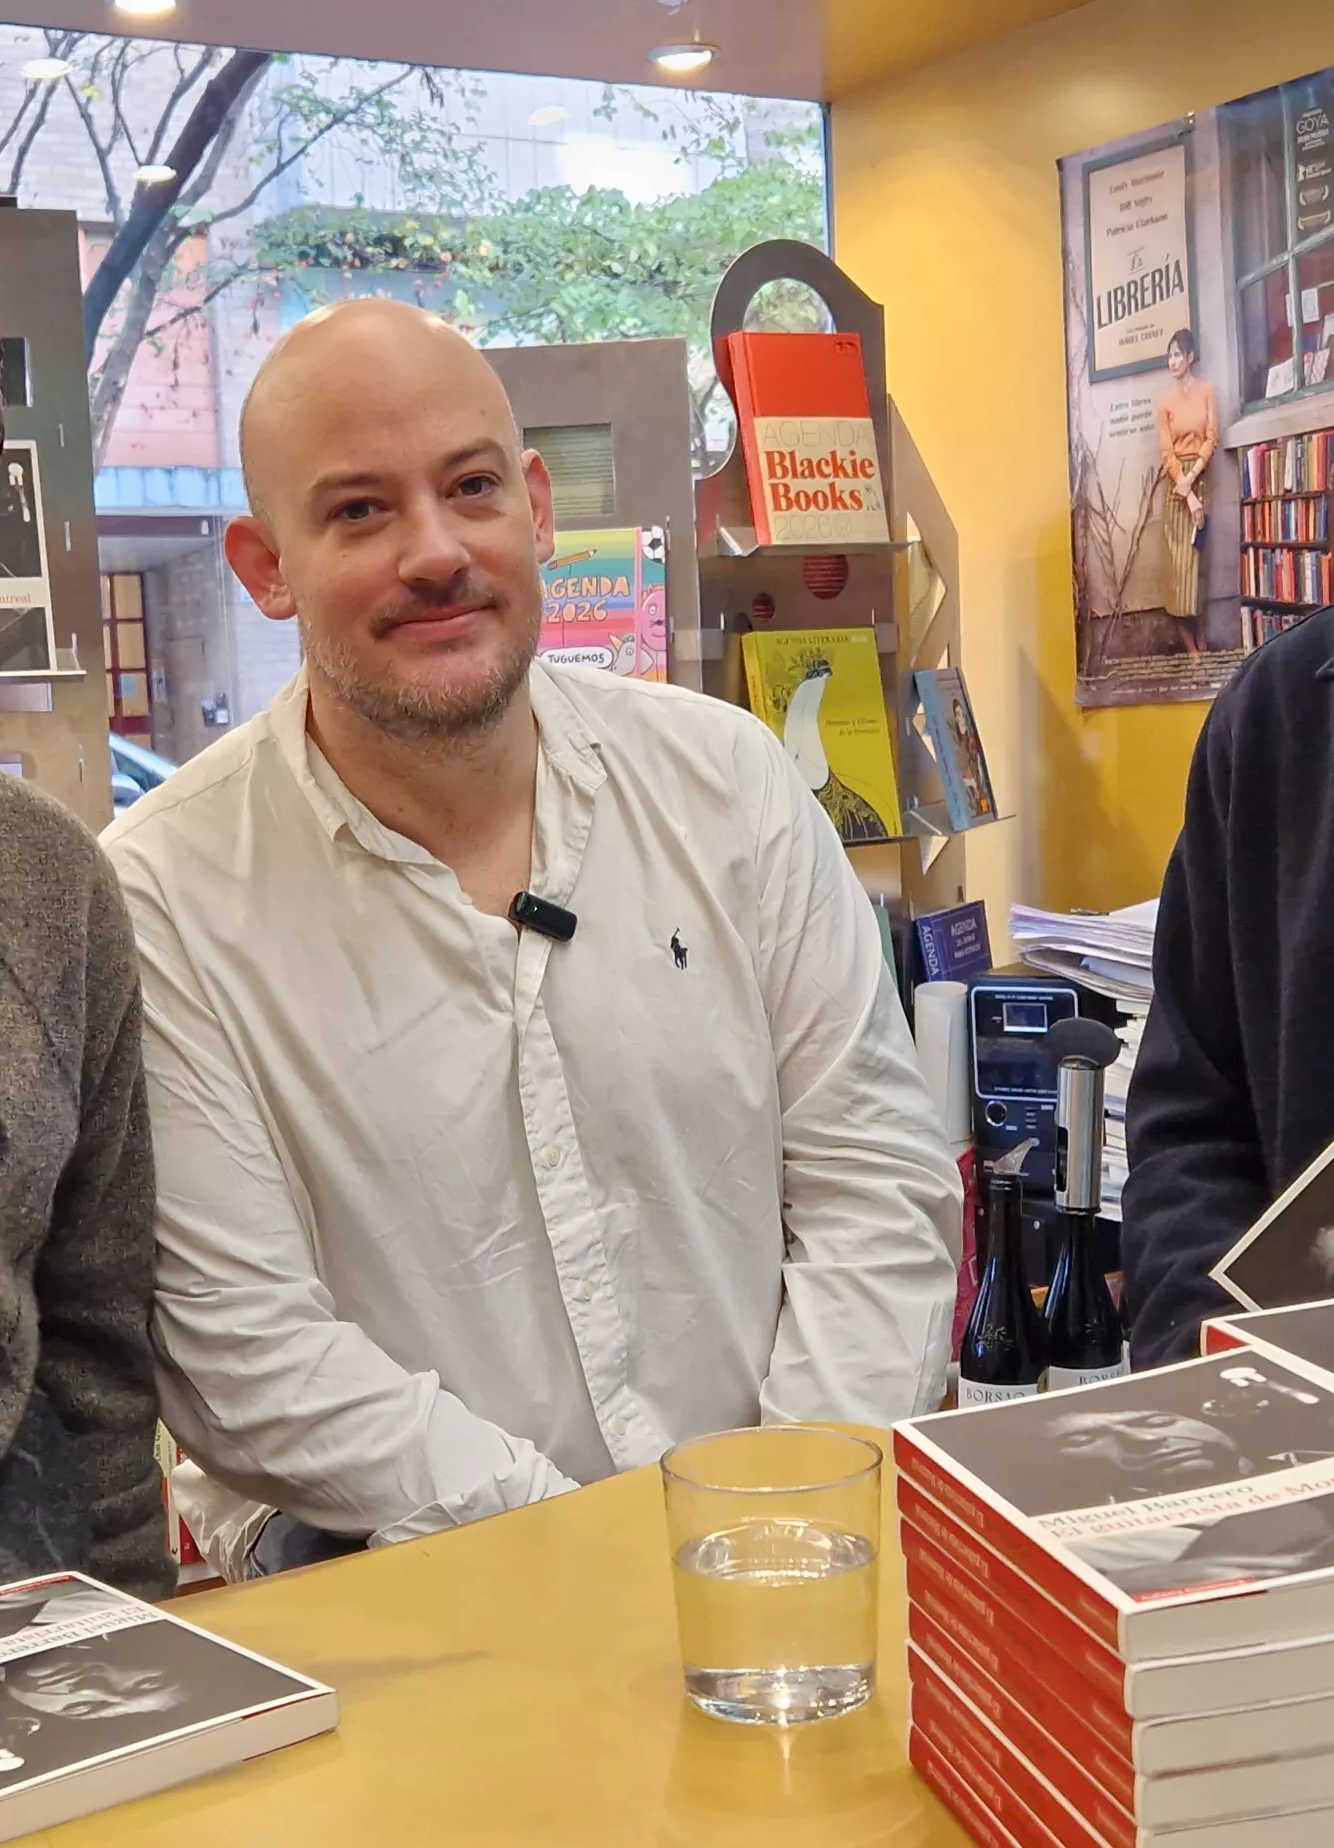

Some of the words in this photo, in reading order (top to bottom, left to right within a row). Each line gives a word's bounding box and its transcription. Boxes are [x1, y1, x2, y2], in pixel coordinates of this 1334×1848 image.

[1296, 113, 1329, 135] GOYA
[1106, 223, 1134, 238] Patricia
[1135, 213, 1169, 230] Clarkson
[1096, 254, 1185, 331] LIBRERÍA
[763, 420, 872, 448] AGENDA
[763, 449, 876, 480] Blackie
[768, 480, 864, 513] Books
[774, 514, 833, 541] 2026
[547, 600, 608, 623] 2026
[547, 654, 605, 665] TUGUEMOS
[950, 917, 978, 937] AGENDA
[921, 924, 940, 977] AGENDA
[1038, 1503, 1136, 1529] Miguel
[1143, 1483, 1255, 1513] Barrero
[1051, 1526, 1090, 1540] El
[1091, 1498, 1240, 1539] guitarrista
[1248, 1488, 1283, 1506] de
[87, 1611, 157, 1637] Miguel
[124, 1604, 146, 1617] El
[3, 1608, 118, 1646] guitarrista
